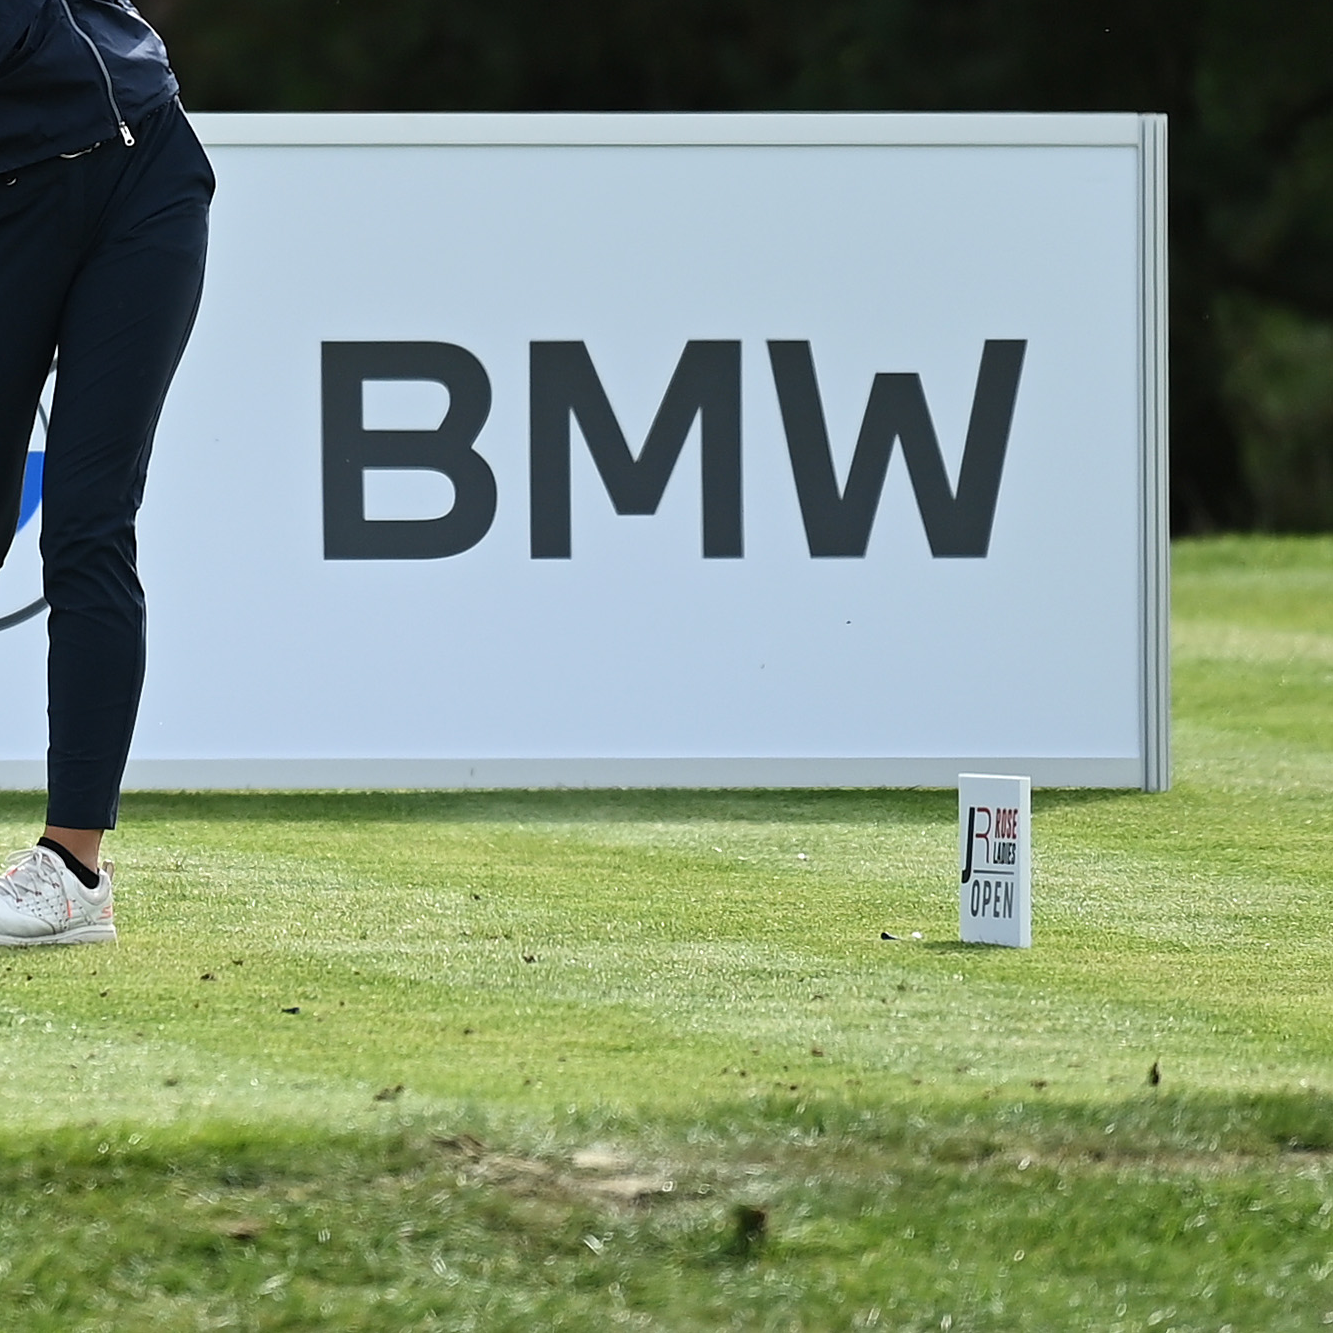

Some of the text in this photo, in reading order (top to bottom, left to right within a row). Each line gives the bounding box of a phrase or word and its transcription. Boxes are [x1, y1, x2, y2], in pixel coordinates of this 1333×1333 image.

[321, 339, 1028, 561] BMW
[994, 807, 1019, 840] ROSE
[992, 841, 1016, 866] LADIES
[970, 879, 1014, 919] OPEN
